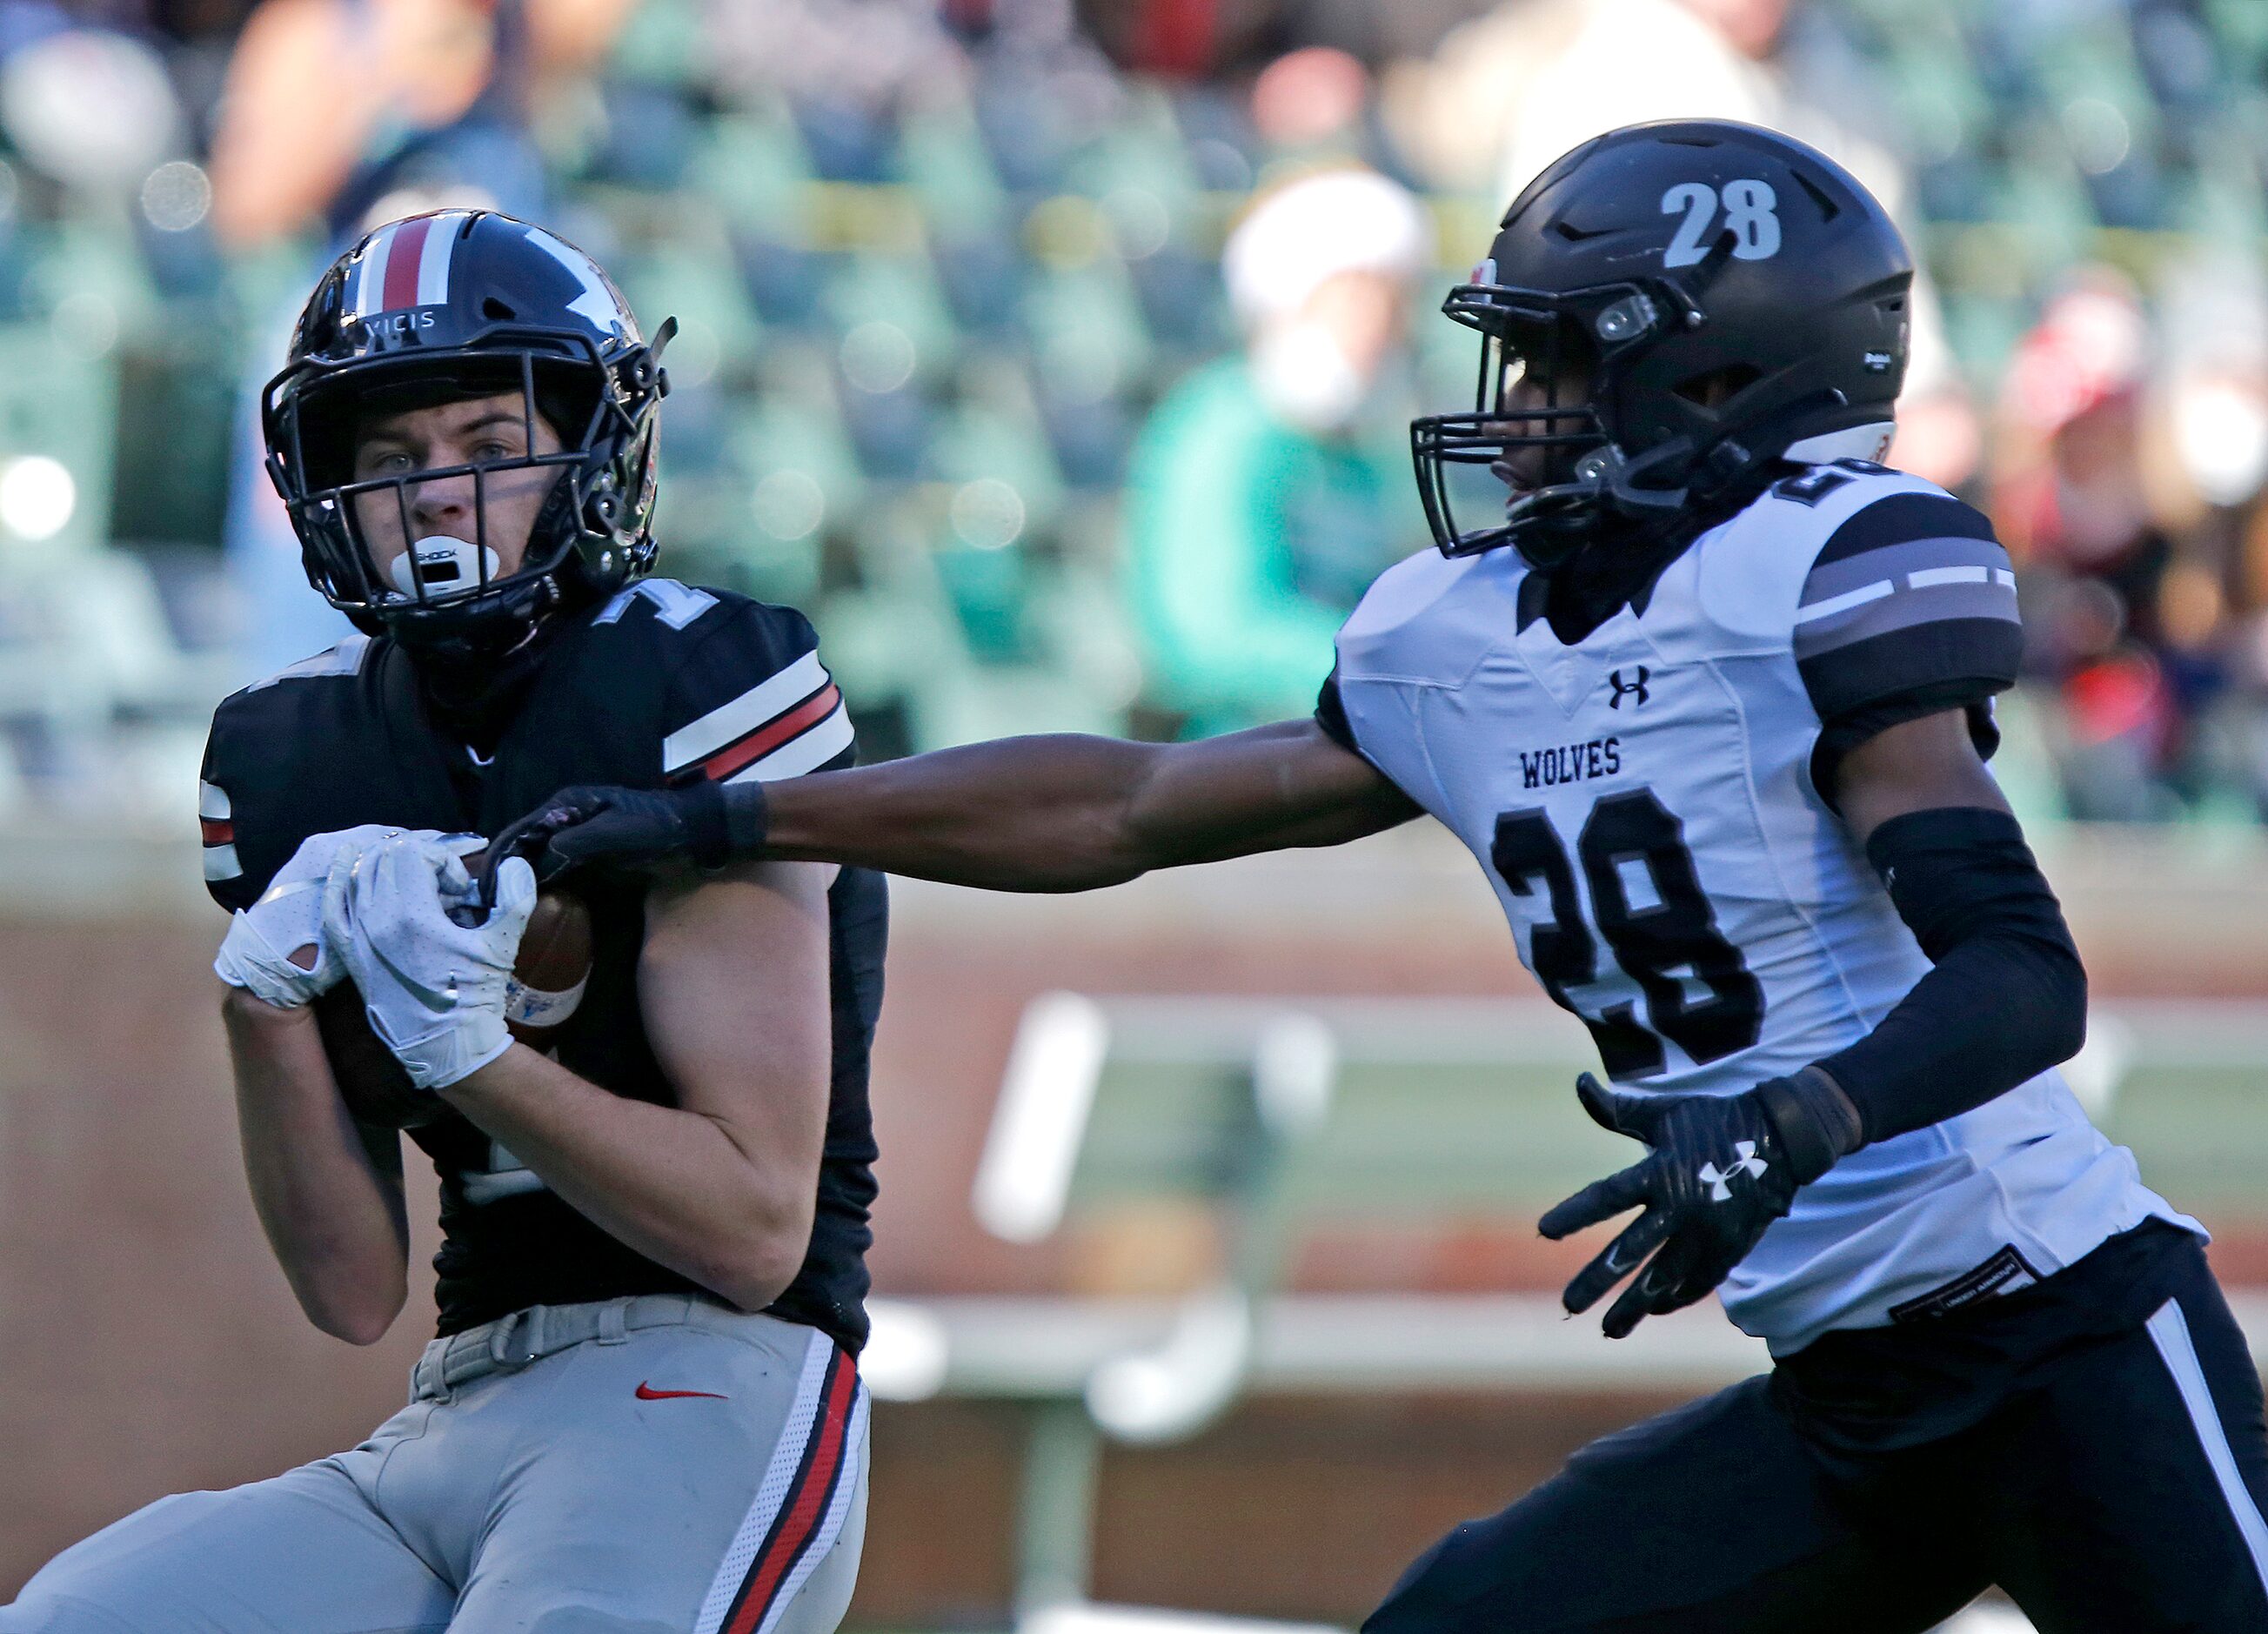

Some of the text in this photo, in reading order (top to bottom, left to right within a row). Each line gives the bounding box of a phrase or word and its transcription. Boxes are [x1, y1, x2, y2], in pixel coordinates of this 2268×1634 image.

[1660, 177, 1783, 270] 28
[365, 311, 435, 338] VICIS
[1519, 737, 1622, 789] WOLVES
[1489, 785, 1767, 1082] 28
